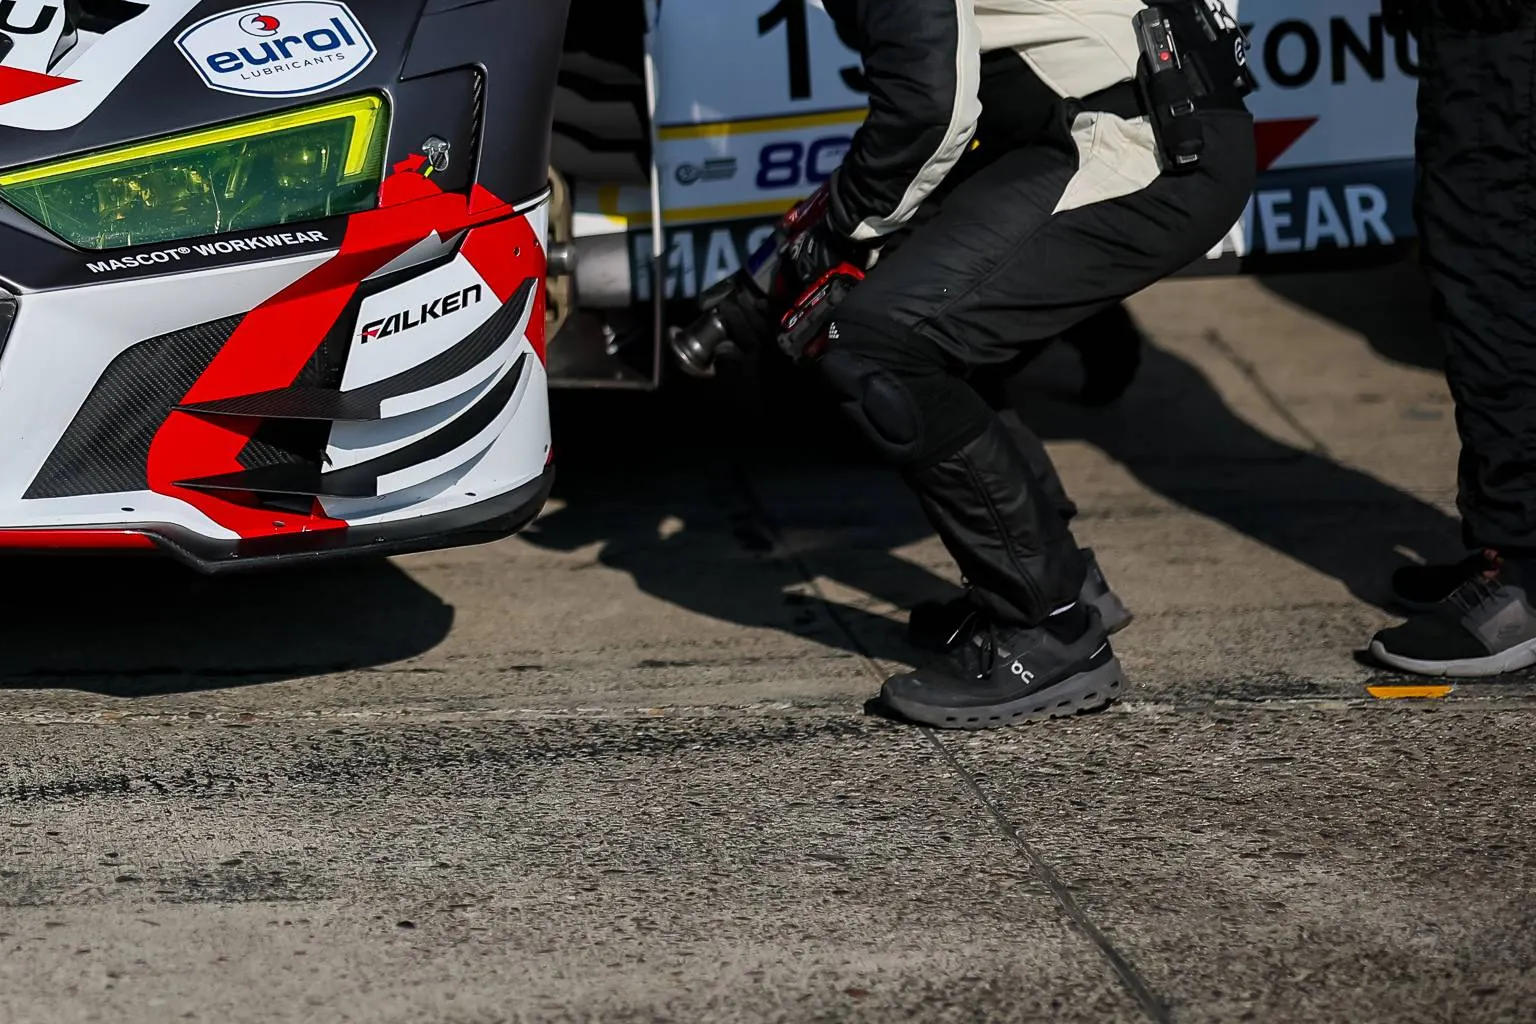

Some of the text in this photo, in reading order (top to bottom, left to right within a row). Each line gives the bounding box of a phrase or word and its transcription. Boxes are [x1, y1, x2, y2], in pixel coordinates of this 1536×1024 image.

[206, 17, 355, 74] eurol
[240, 52, 346, 81] LUBRICANTS
[195, 231, 329, 257] WORKWEAR
[357, 283, 482, 345] FALKEN
